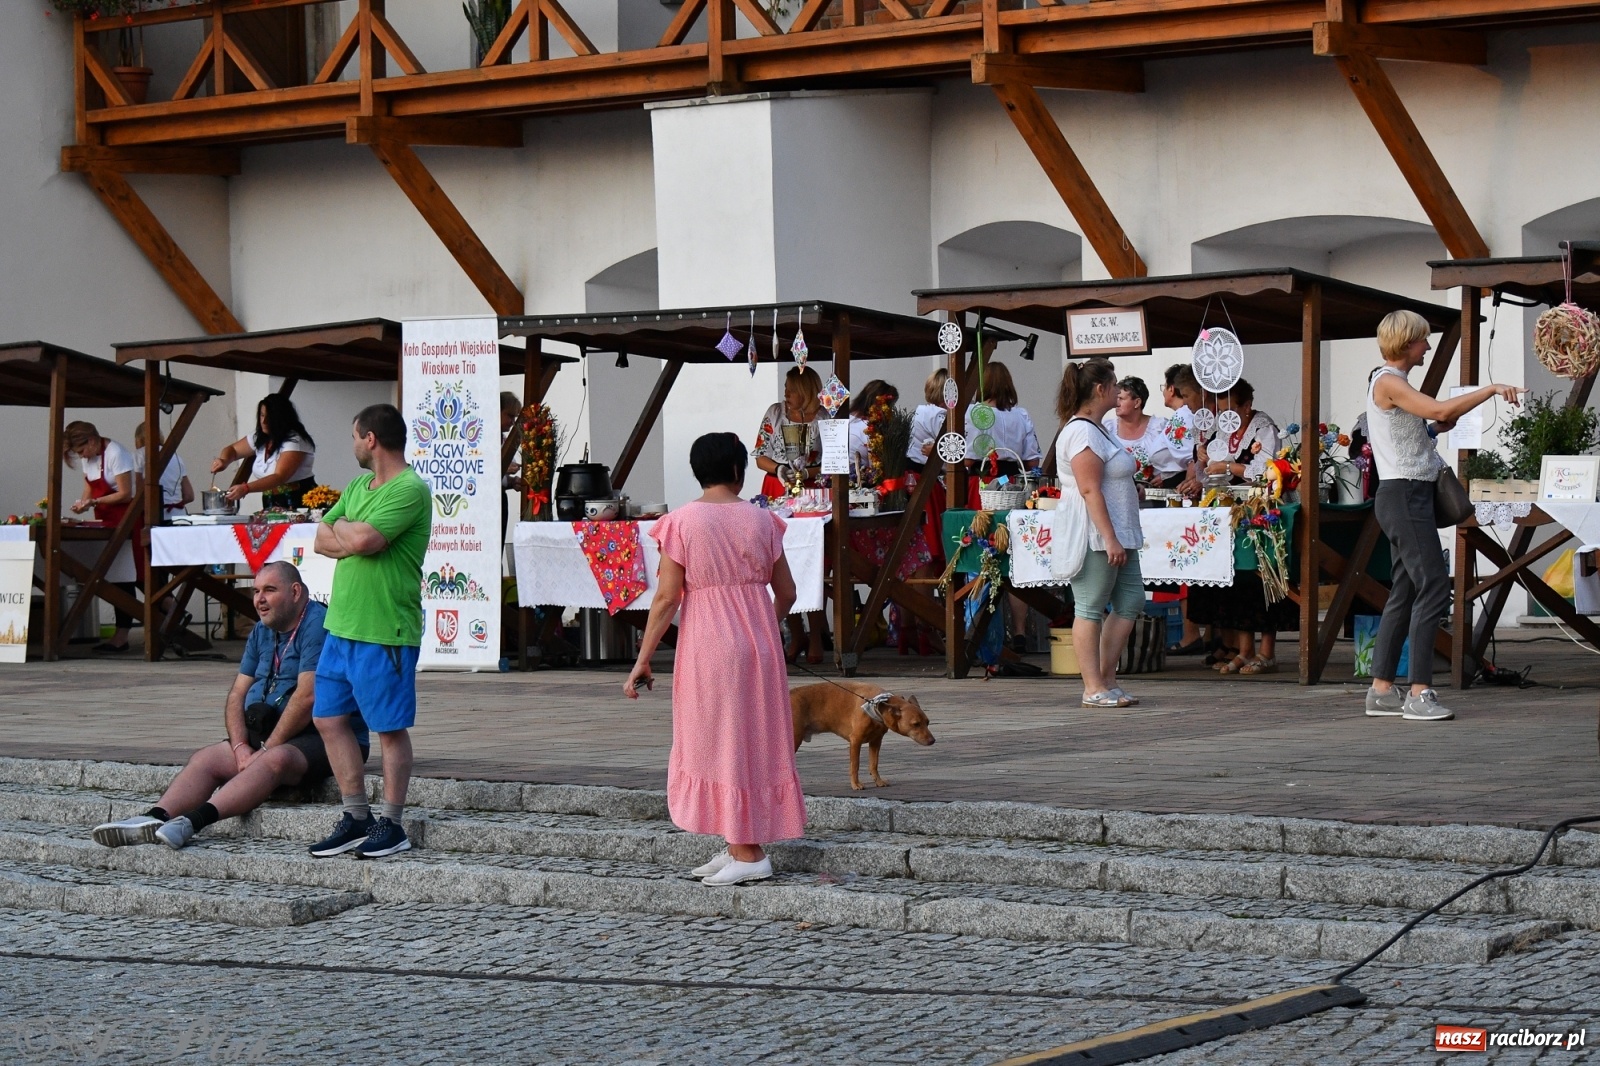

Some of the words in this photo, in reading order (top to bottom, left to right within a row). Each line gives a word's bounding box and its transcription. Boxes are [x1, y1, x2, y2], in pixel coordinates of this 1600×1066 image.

[403, 342, 420, 357] Koło
[421, 340, 458, 359] Gospodyń
[460, 340, 497, 357] Wiejskich
[421, 360, 460, 375] Wioskowe
[462, 360, 476, 374] Trio
[433, 443, 465, 459] KGW
[412, 459, 484, 475] WIOSKOWE
[433, 475, 463, 490] TRIO
[431, 523, 458, 537] jątkowe
[460, 523, 476, 535] Koło
[460, 539, 482, 552] Kobiet
